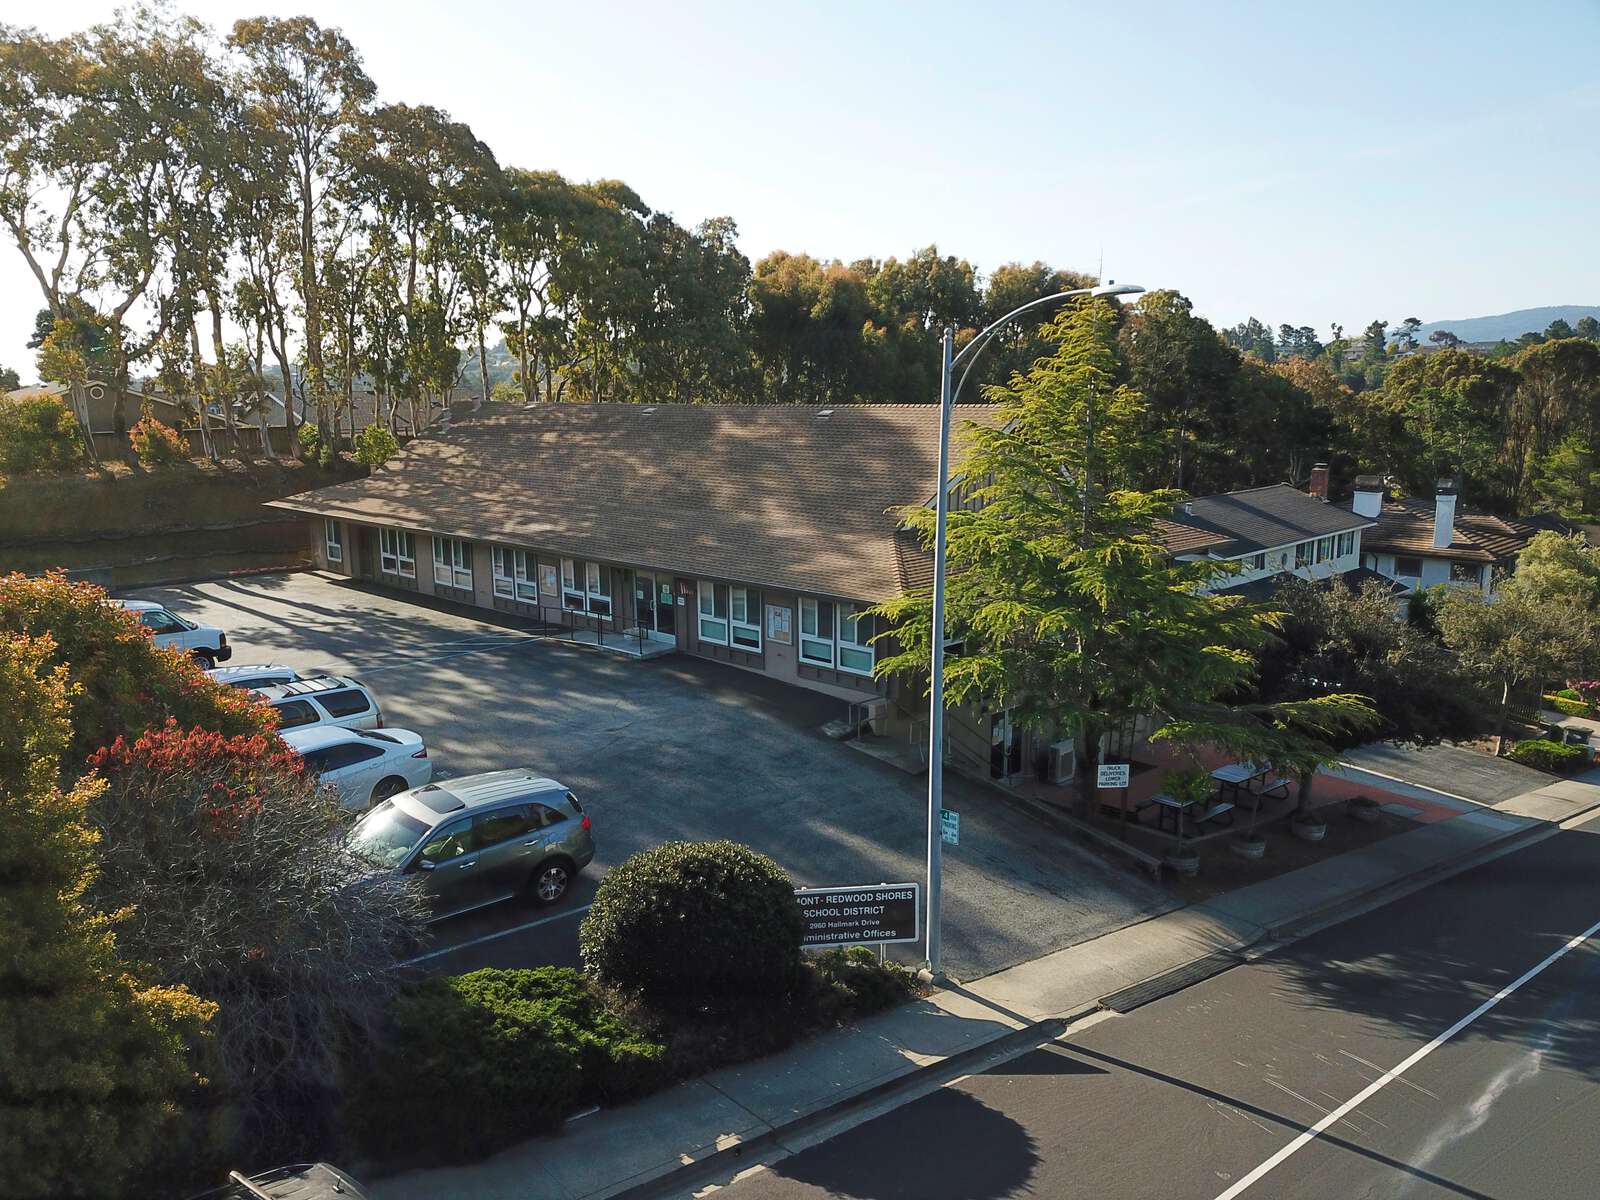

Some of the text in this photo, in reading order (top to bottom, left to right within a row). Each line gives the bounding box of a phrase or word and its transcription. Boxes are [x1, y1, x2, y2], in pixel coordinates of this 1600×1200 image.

[826, 893, 874, 904] REDWOOD
[875, 890, 913, 901] SHORES
[803, 906, 885, 918] SCHOOL DISTRICT
[828, 920, 860, 928] Hallmark
[803, 929, 897, 942] ministrative Offices
